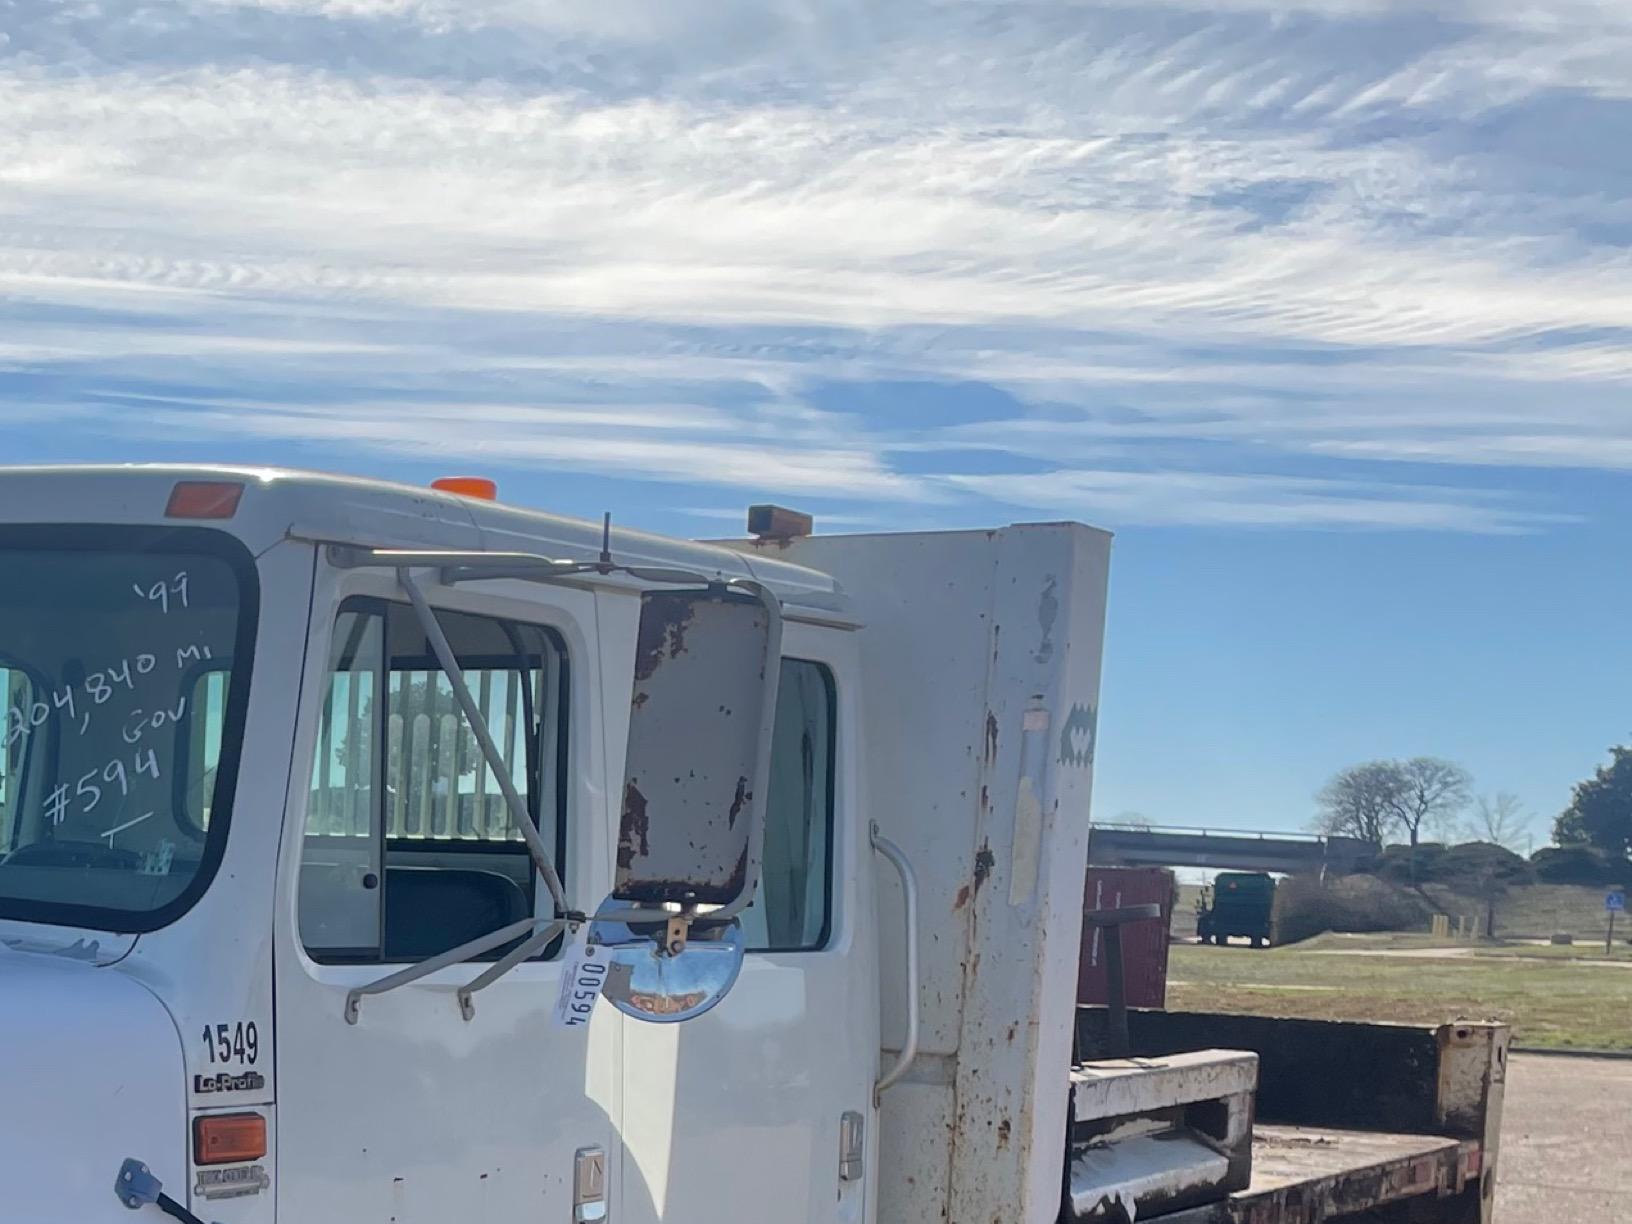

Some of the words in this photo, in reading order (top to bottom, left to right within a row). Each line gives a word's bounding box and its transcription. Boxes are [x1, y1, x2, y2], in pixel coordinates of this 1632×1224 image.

[2, 653, 156, 748] 204,840
[43, 749, 160, 826] #594
[565, 963, 606, 1026] 00594
[202, 1021, 259, 1066] 1549
